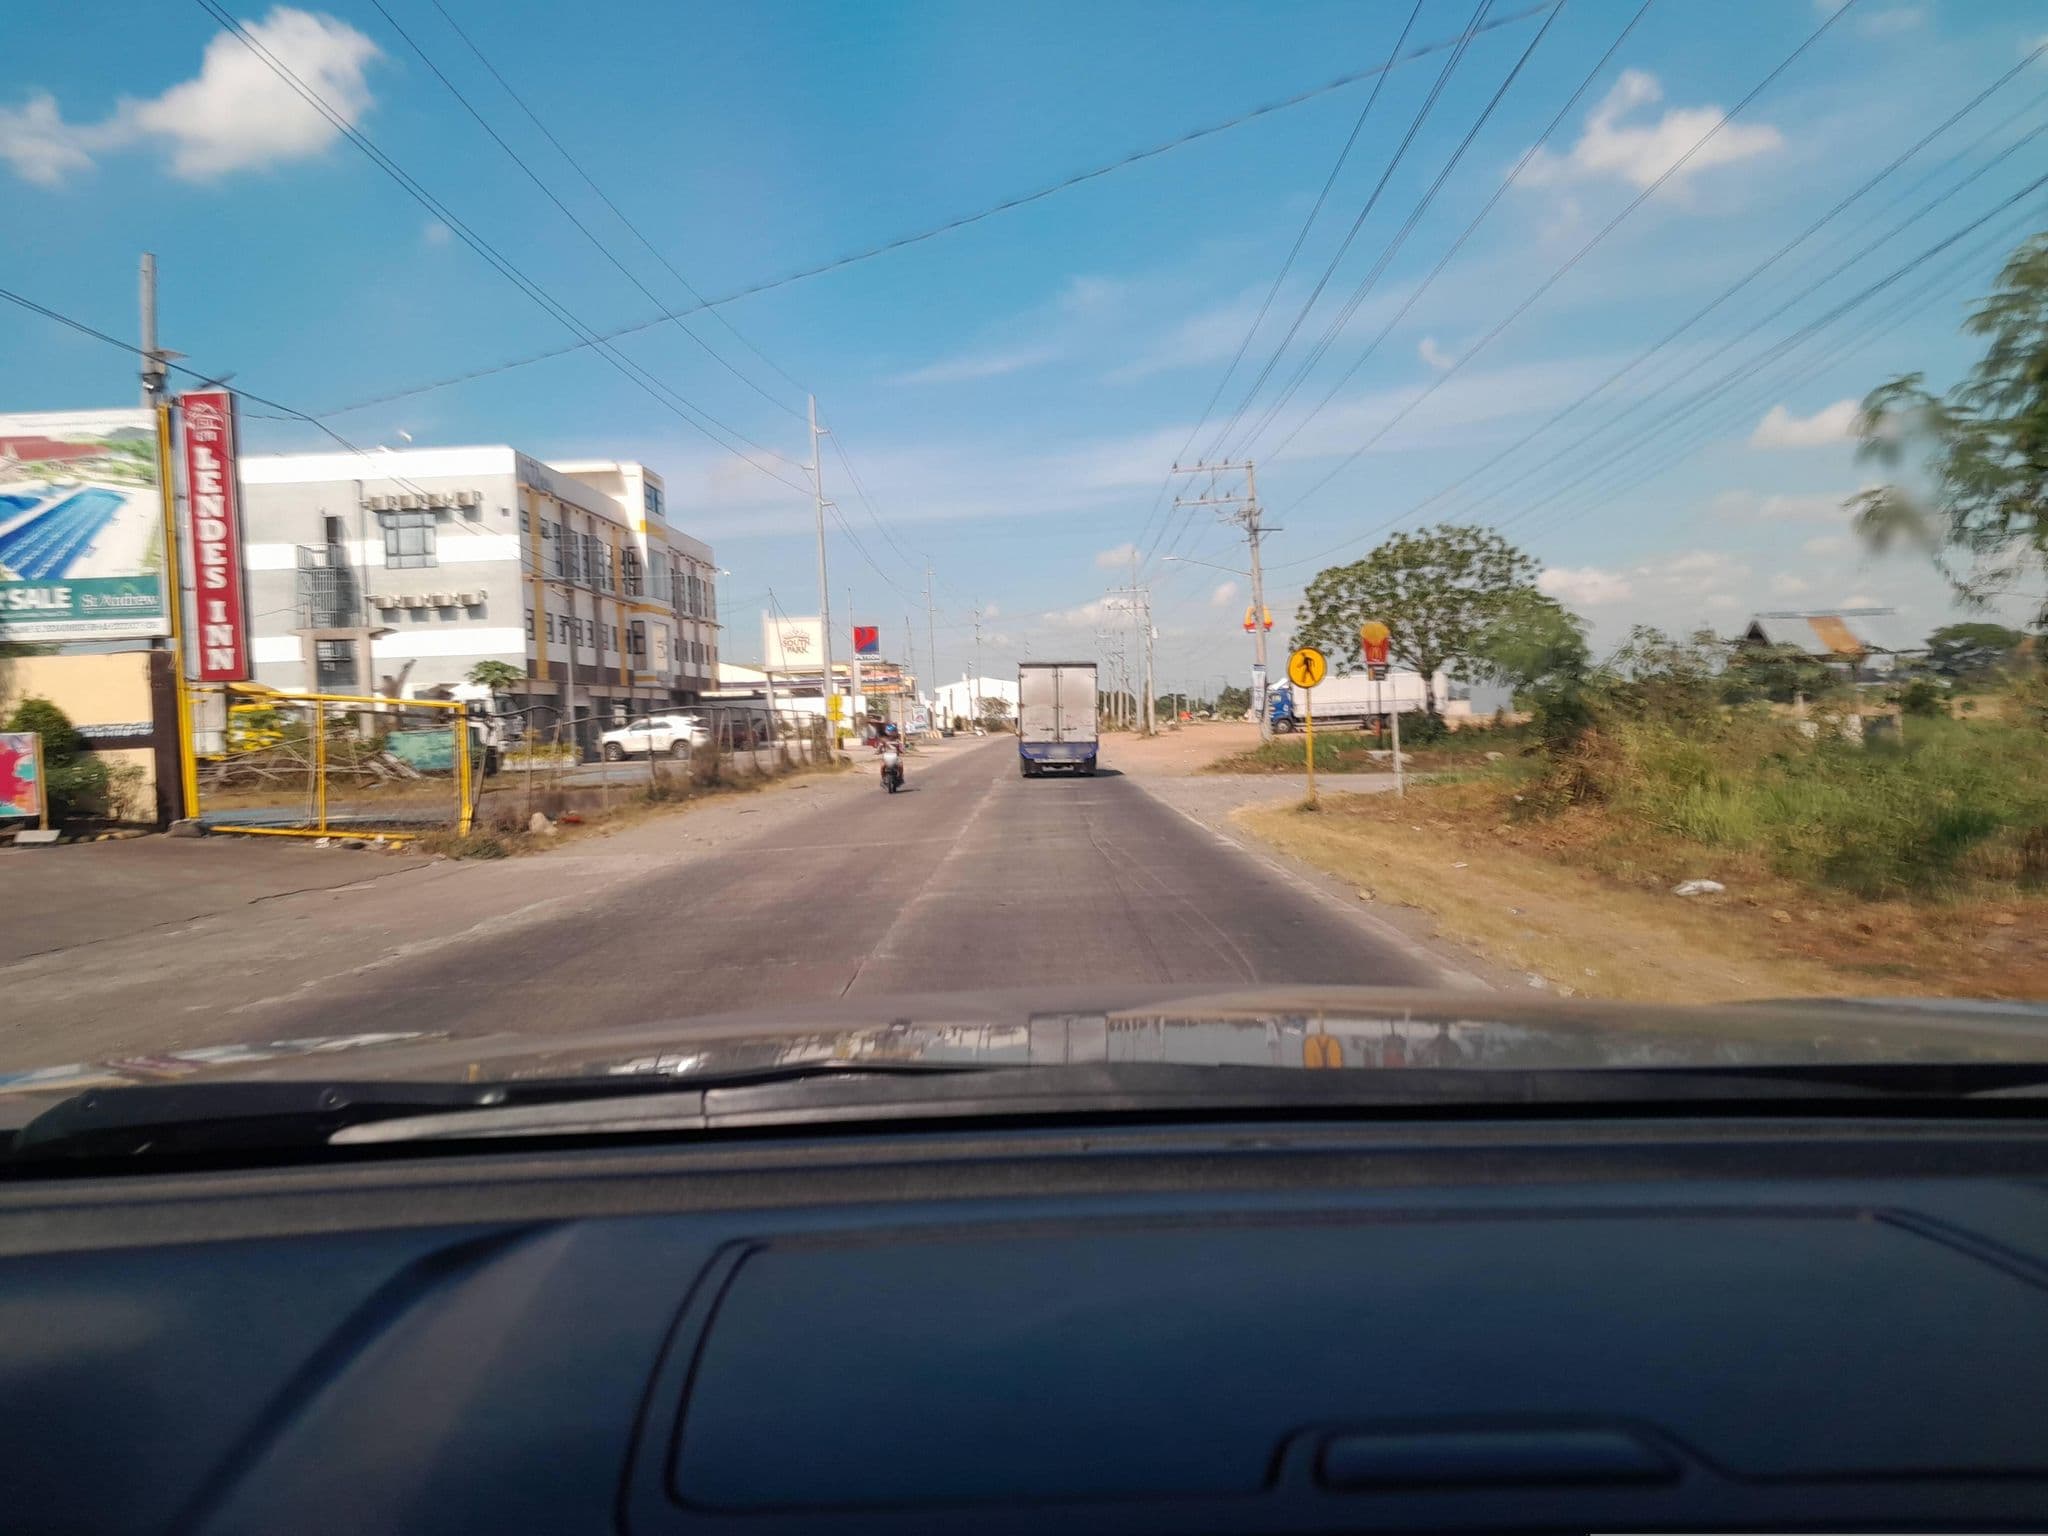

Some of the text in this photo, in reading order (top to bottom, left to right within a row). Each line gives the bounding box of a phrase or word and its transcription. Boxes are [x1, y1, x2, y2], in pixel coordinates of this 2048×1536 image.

[194, 447, 227, 589] LENDES
[8, 588, 73, 610] SALE
[207, 600, 235, 670] INN
